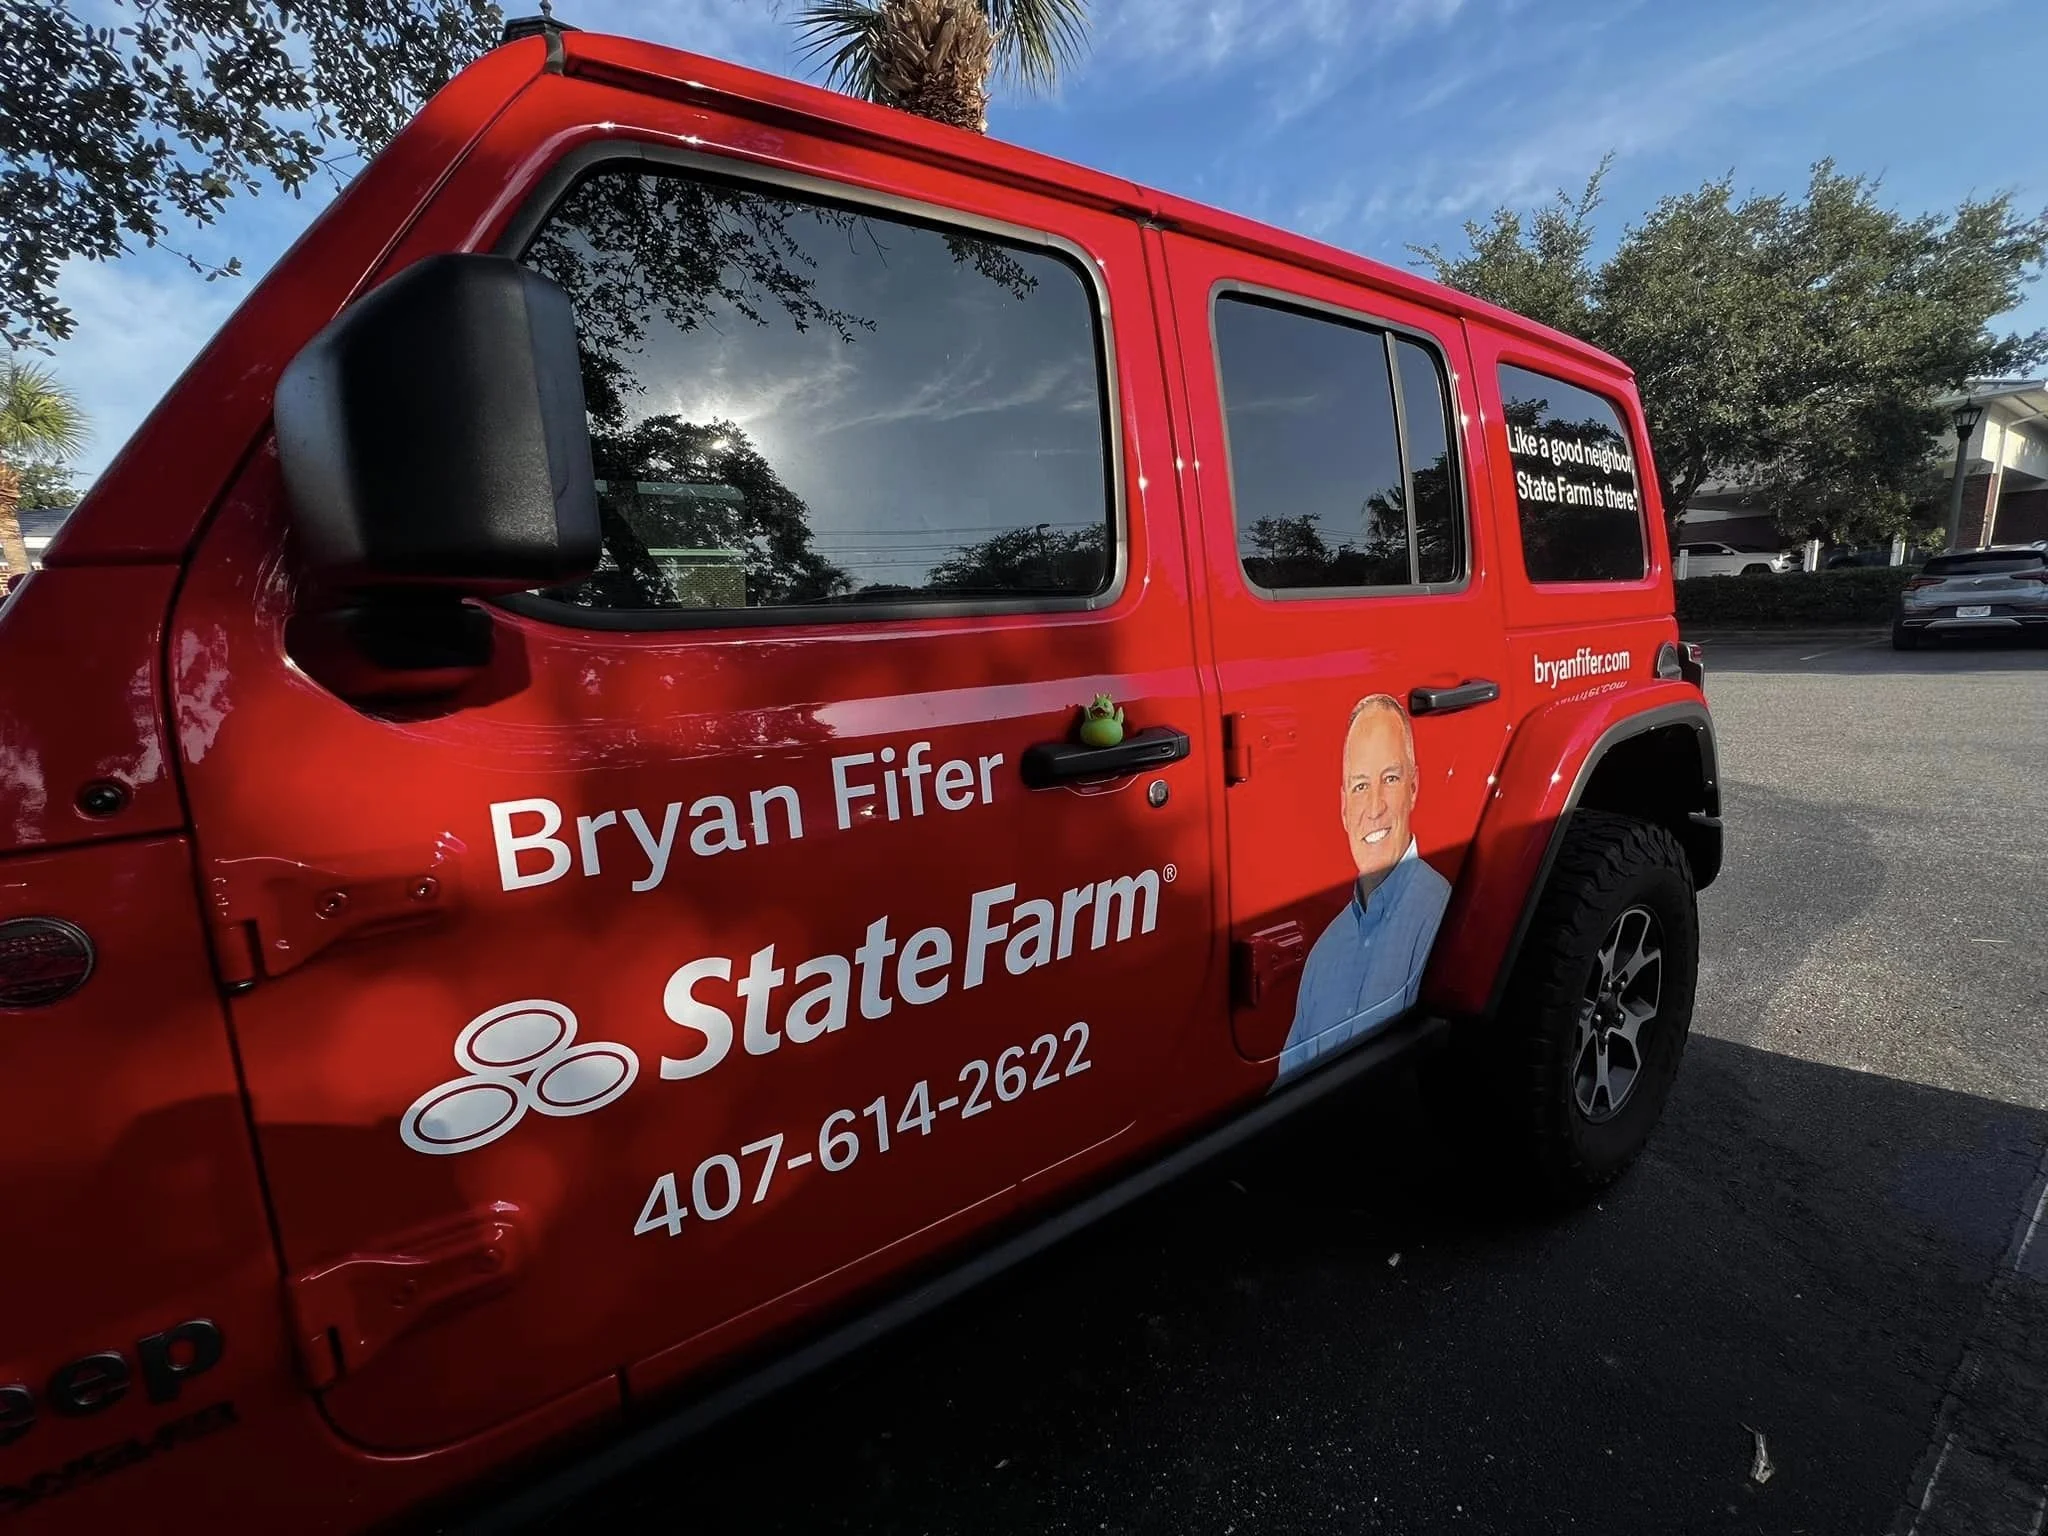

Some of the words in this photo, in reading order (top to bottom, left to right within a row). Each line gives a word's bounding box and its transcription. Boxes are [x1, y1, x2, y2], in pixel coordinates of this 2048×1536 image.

[1505, 424, 1538, 456] Like
[1539, 437, 1550, 459] a
[1550, 438, 1584, 466] good
[1584, 443, 1636, 477] neighbor,
[1516, 470, 1556, 501] State
[1557, 476, 1593, 506] Farm
[1592, 481, 1605, 507] is
[1533, 647, 1630, 689] bryanfifer.com
[490, 785, 804, 892] Bryan
[832, 741, 1004, 830] Fifer
[633, 1021, 1092, 1238] 407-614-2622
